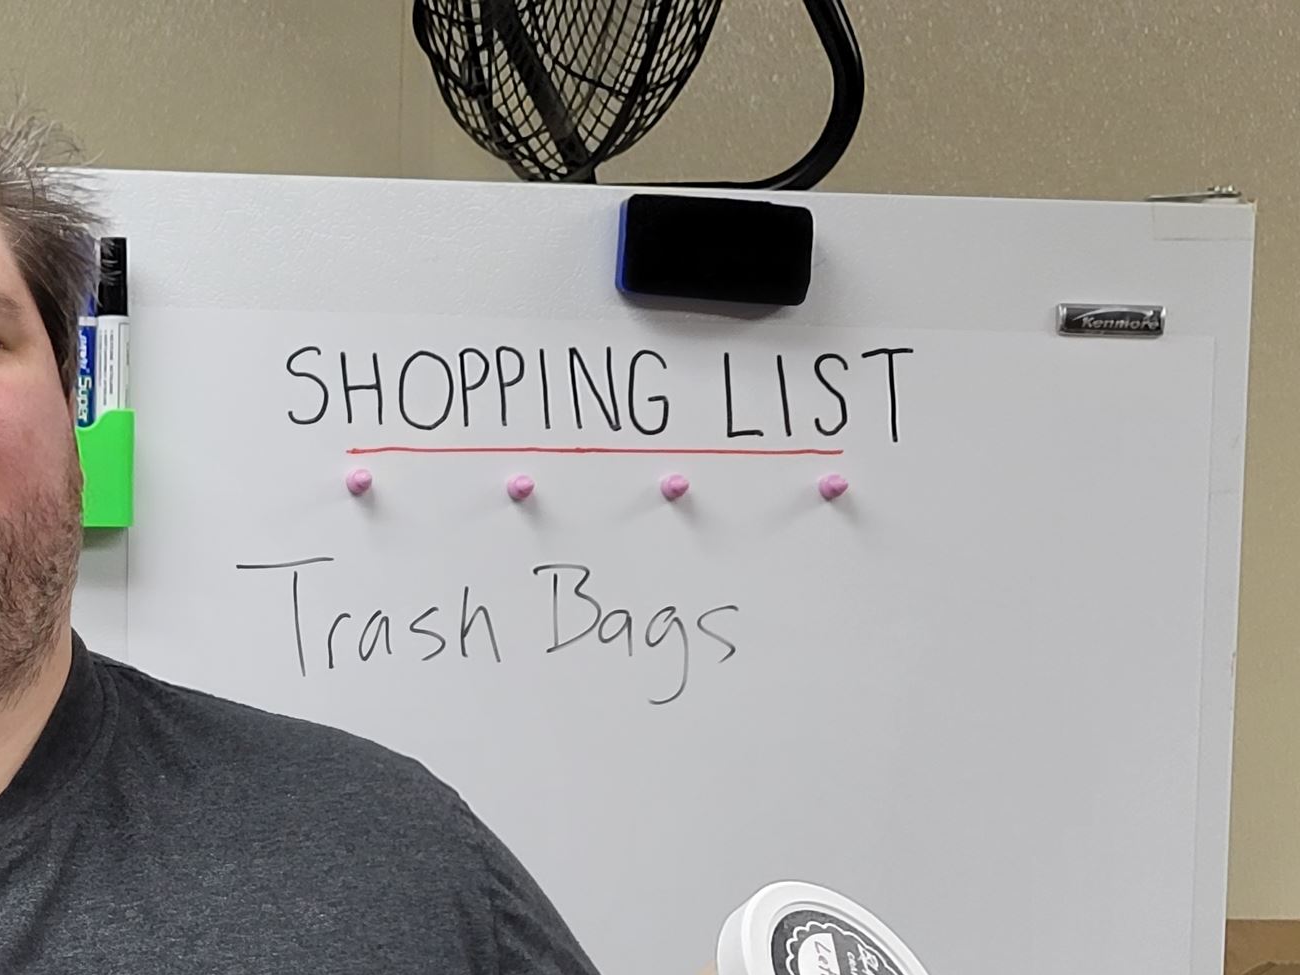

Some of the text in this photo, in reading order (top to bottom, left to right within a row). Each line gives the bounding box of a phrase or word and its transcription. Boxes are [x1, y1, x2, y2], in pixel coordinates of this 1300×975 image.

[1081, 317, 1160, 330] Kenmore
[286, 346, 913, 443] SHOPPING LIST
[236, 557, 740, 704] Trash Bags
